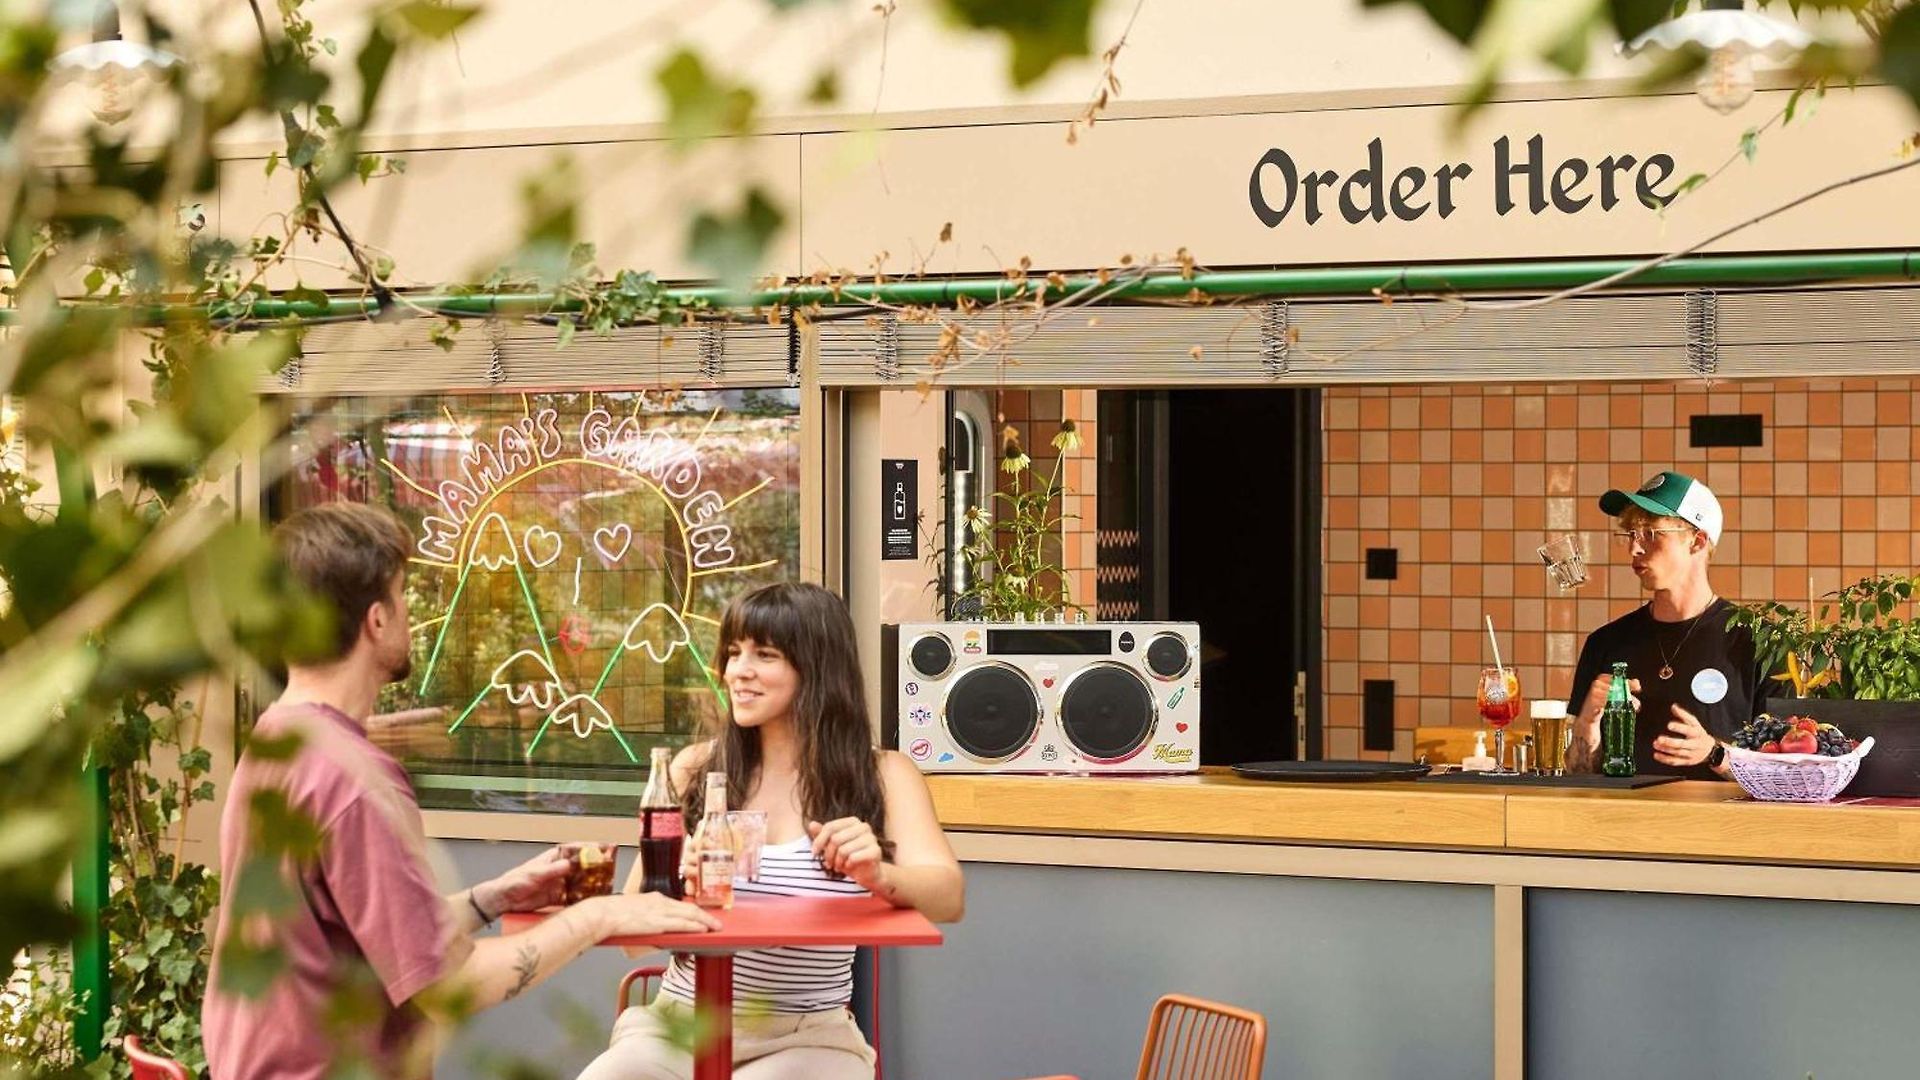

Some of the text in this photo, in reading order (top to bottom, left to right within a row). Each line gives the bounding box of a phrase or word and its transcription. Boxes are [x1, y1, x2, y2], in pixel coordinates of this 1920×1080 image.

[1248, 133, 1681, 229] Order Here
[417, 407, 562, 562] MAMA'S
